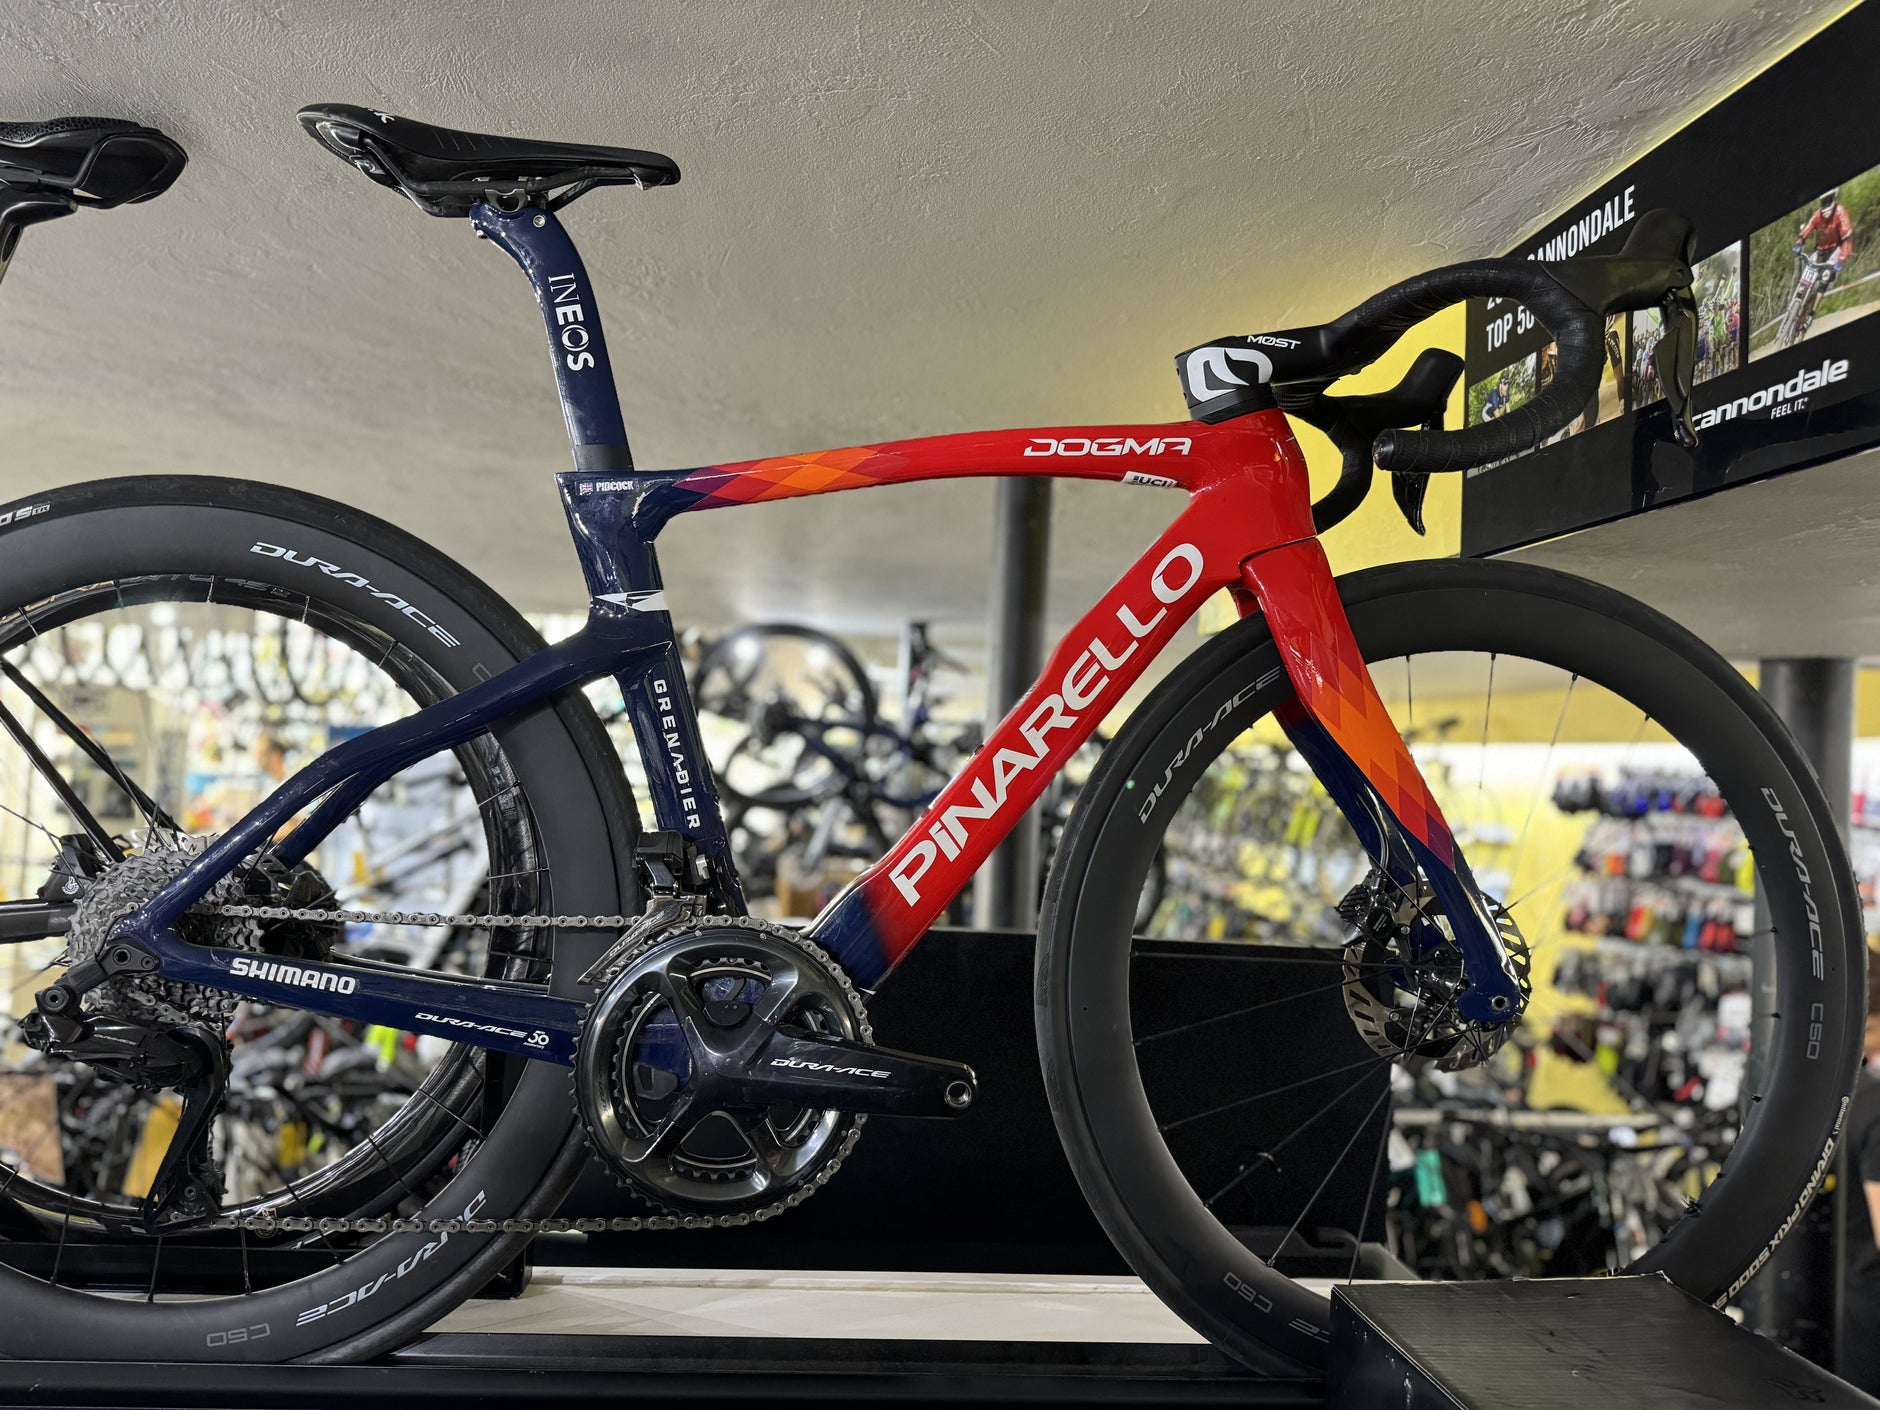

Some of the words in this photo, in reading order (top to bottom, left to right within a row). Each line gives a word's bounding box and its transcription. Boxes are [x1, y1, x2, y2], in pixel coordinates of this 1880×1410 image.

[548, 272, 595, 371] INEOS
[1486, 313, 1513, 352] TOP
[1691, 359, 1849, 432] cannondale
[1770, 403, 1792, 420] FEEL
[1023, 437, 1192, 457] DOGMA
[596, 480, 634, 492] PIDCOCK
[250, 541, 461, 648] DURA-ACE
[888, 542, 1205, 908] PINARELLO
[1138, 665, 1281, 824] DURA-ACE
[653, 679, 701, 830] GRENADIER
[1760, 787, 1824, 981] DURA-ACE
[229, 957, 356, 995] SHIMANO
[414, 1012, 528, 1039] DURA-ACE
[1806, 1002, 1824, 1060] C50
[770, 1058, 892, 1079] DURA-ACE
[1799, 1137, 1835, 1208] GRAND
[1768, 1202, 1801, 1252] PRIX
[1223, 1271, 1273, 1314] C50
[206, 1322, 271, 1348] C50
